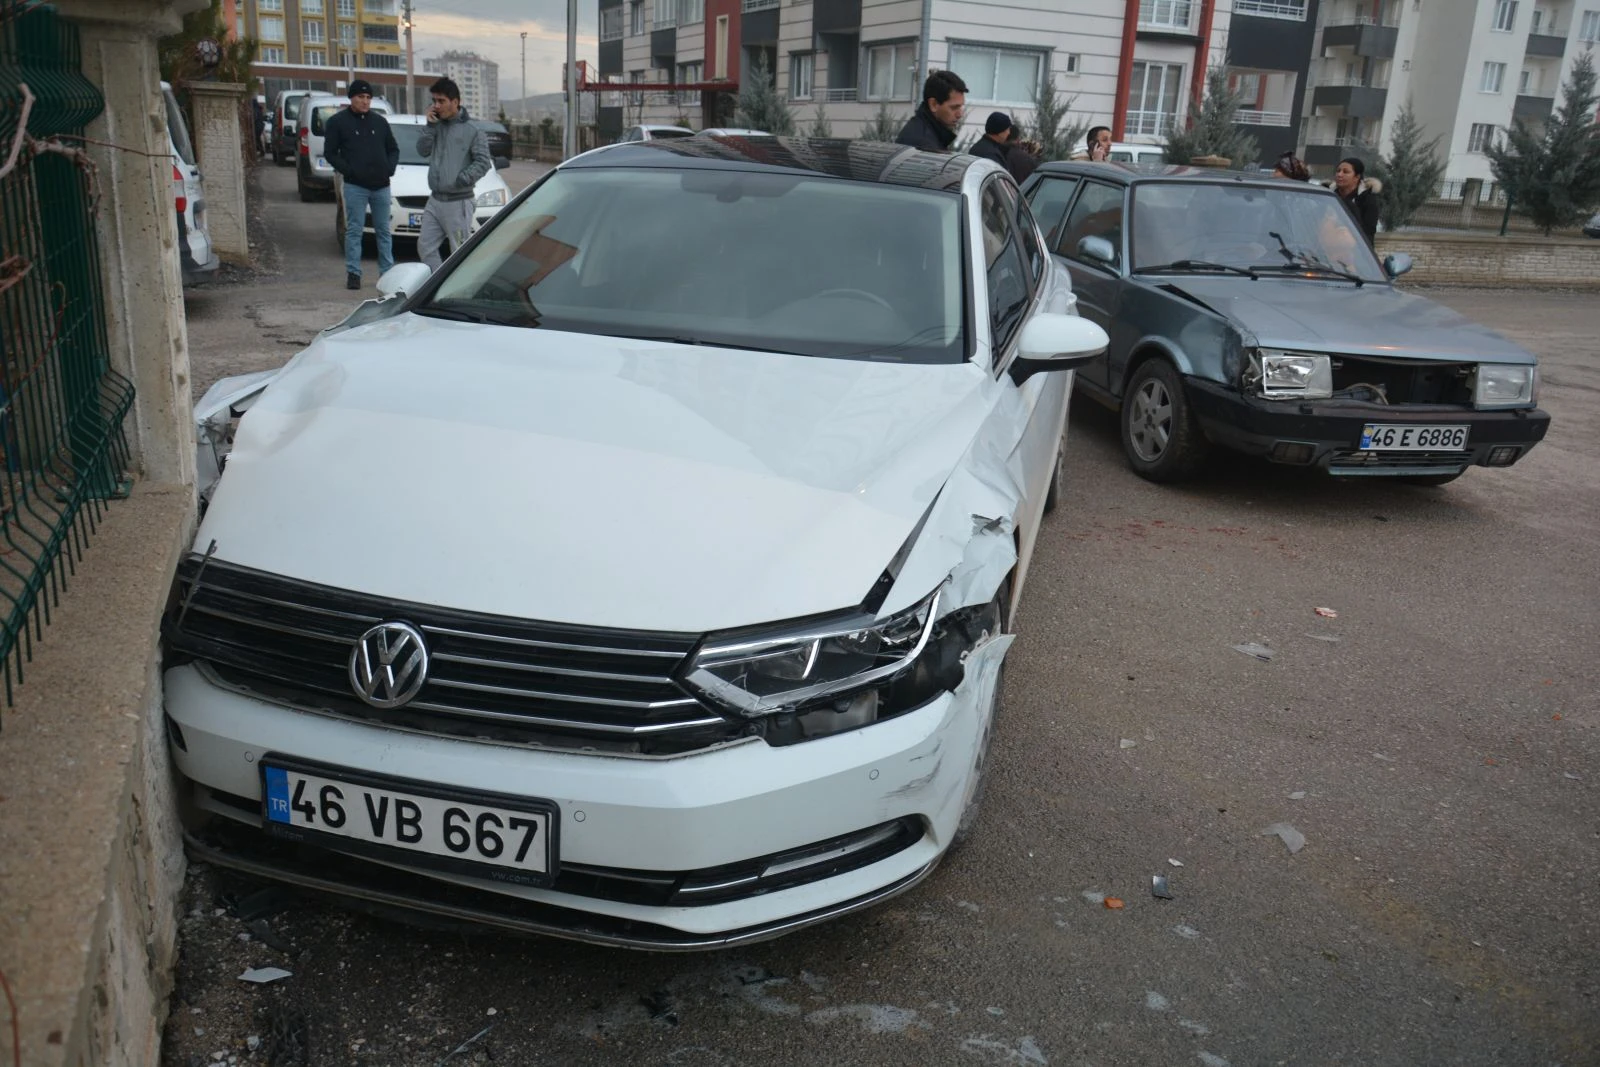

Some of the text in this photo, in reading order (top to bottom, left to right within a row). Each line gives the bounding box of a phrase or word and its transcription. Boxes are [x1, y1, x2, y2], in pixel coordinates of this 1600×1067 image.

[1371, 429, 1465, 446] 46 E 6886
[271, 797, 288, 813] TR
[291, 779, 538, 863] 46 VB 667
